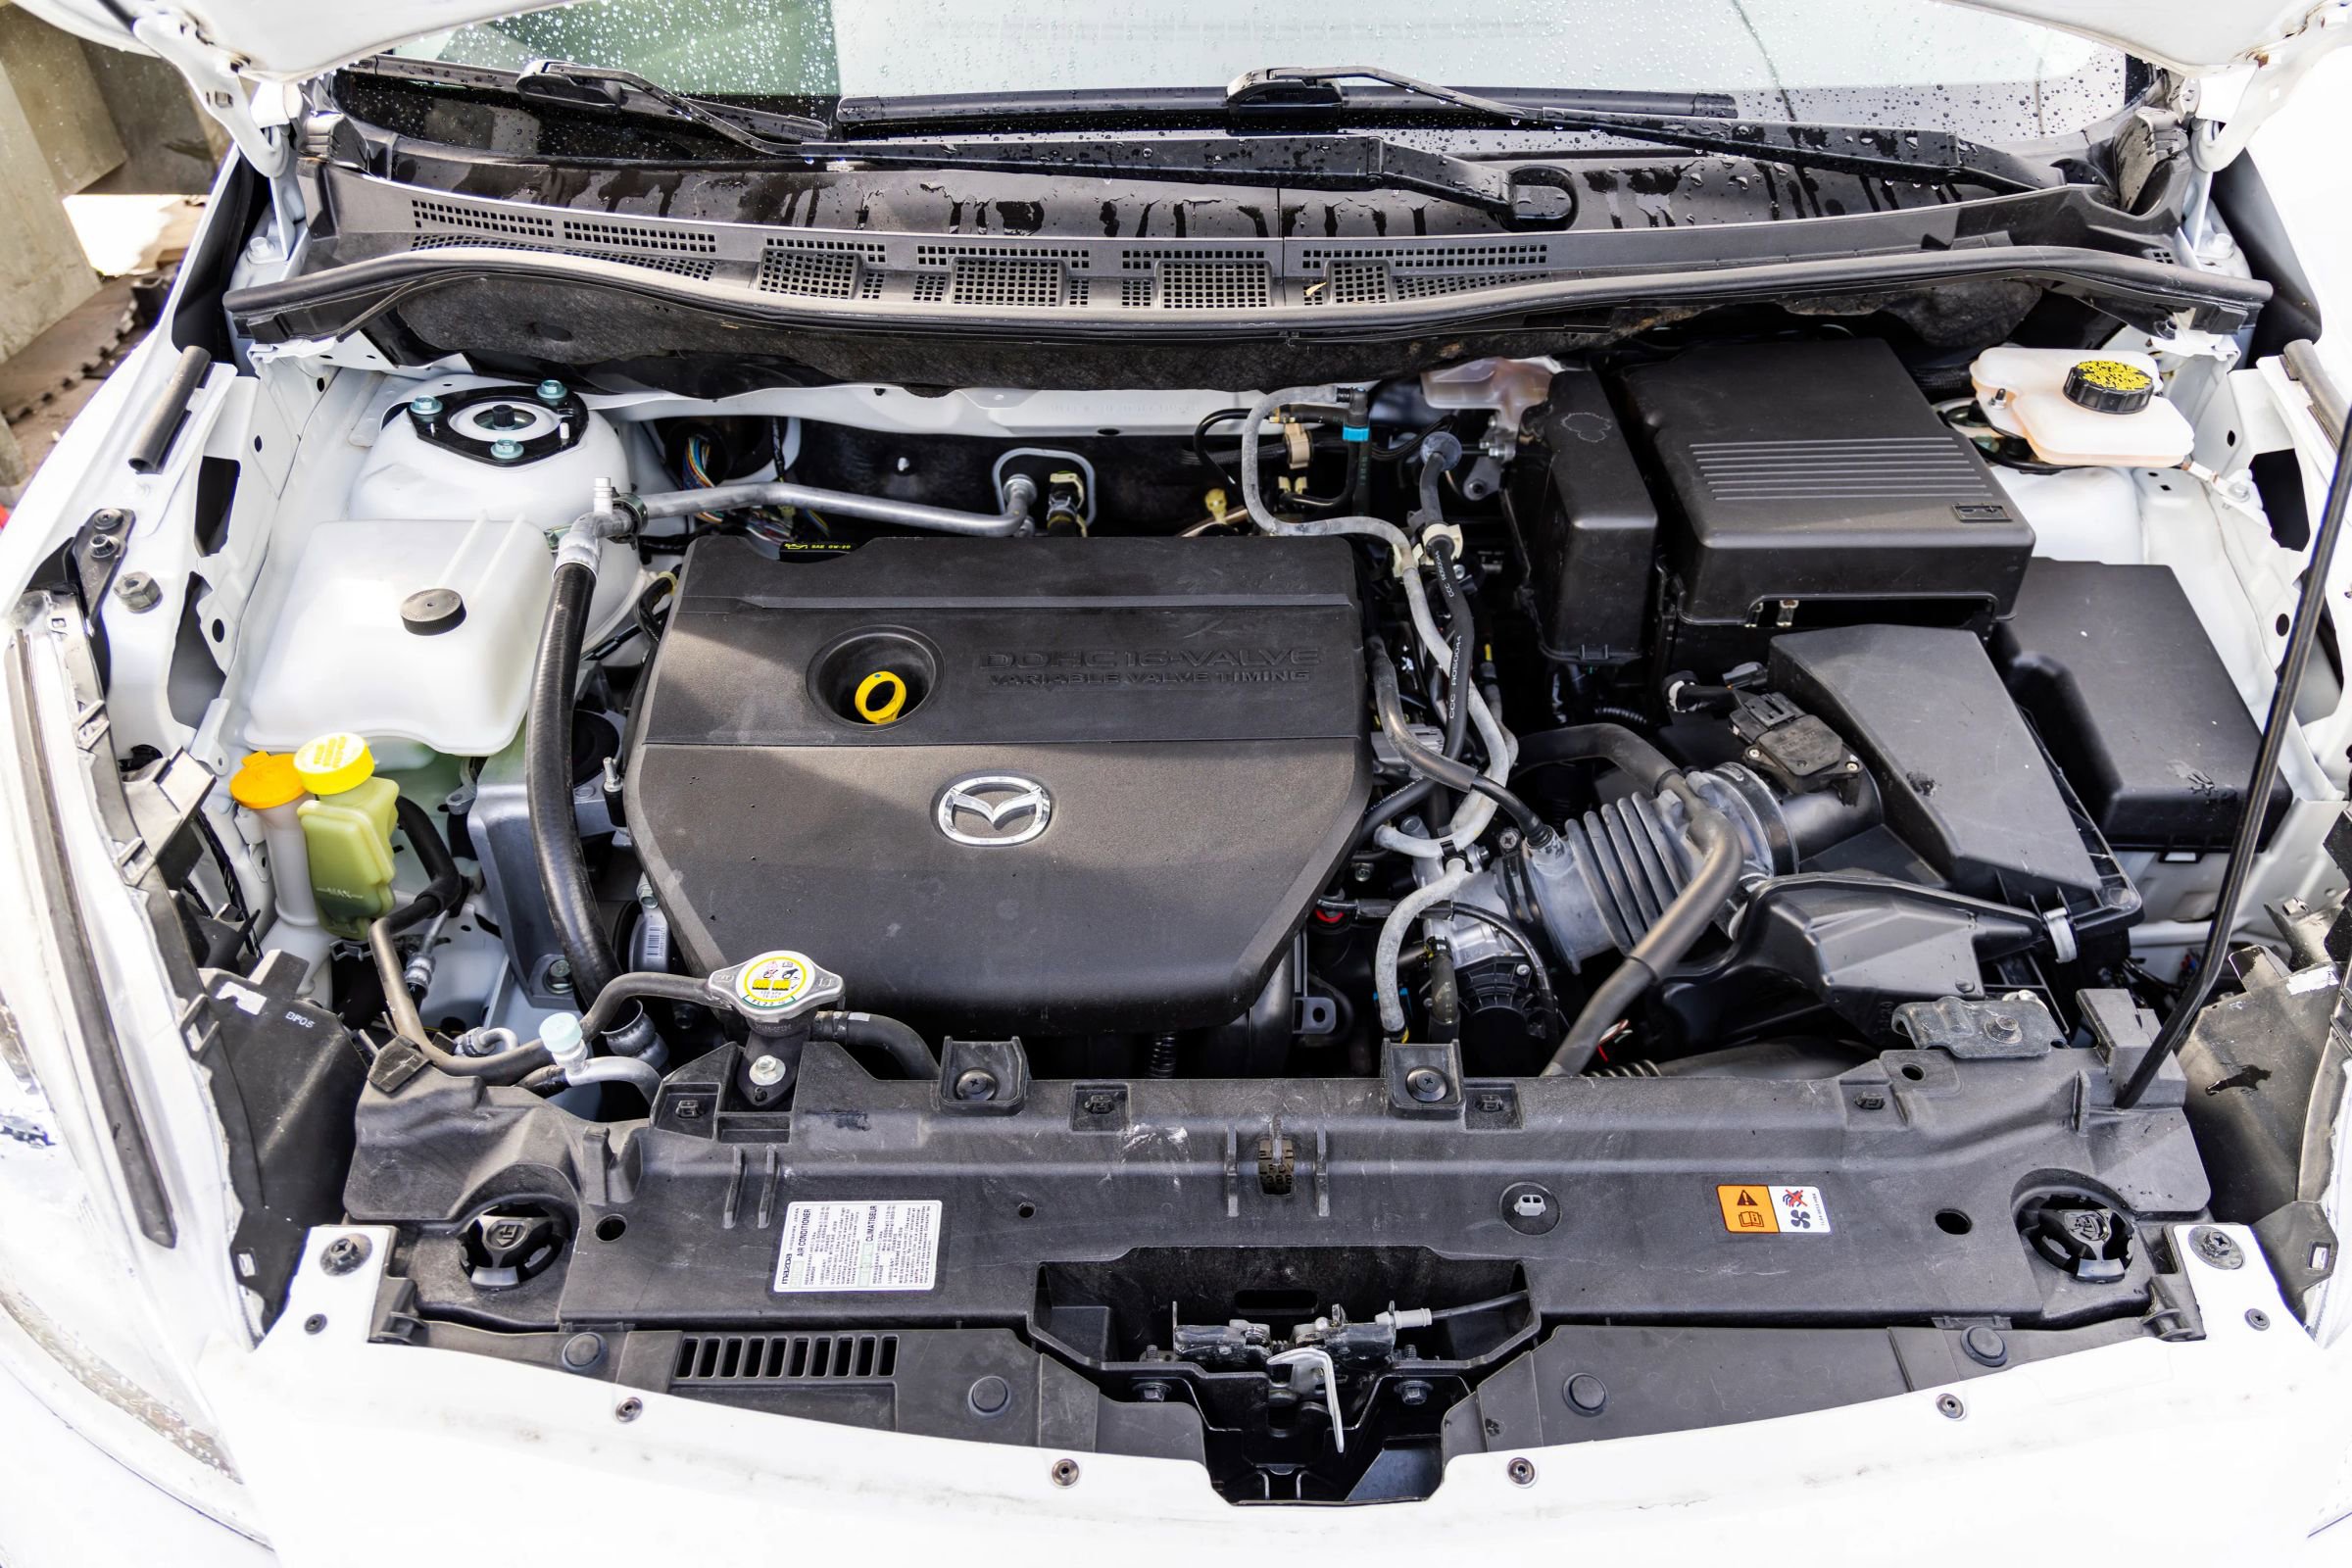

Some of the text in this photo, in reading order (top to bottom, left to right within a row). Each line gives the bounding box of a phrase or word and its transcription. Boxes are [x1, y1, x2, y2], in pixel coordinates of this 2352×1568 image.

[1444, 582, 1455, 597] CCC
[982, 648, 1321, 669] DOHC 16-VALVE
[989, 669, 1311, 686] VARIABLE VALVE TIMING
[796, 1208, 811, 1256] AIR CONDITIONER
[865, 1205, 877, 1241] CLIMATISEUR
[780, 1253, 793, 1284] mazda
